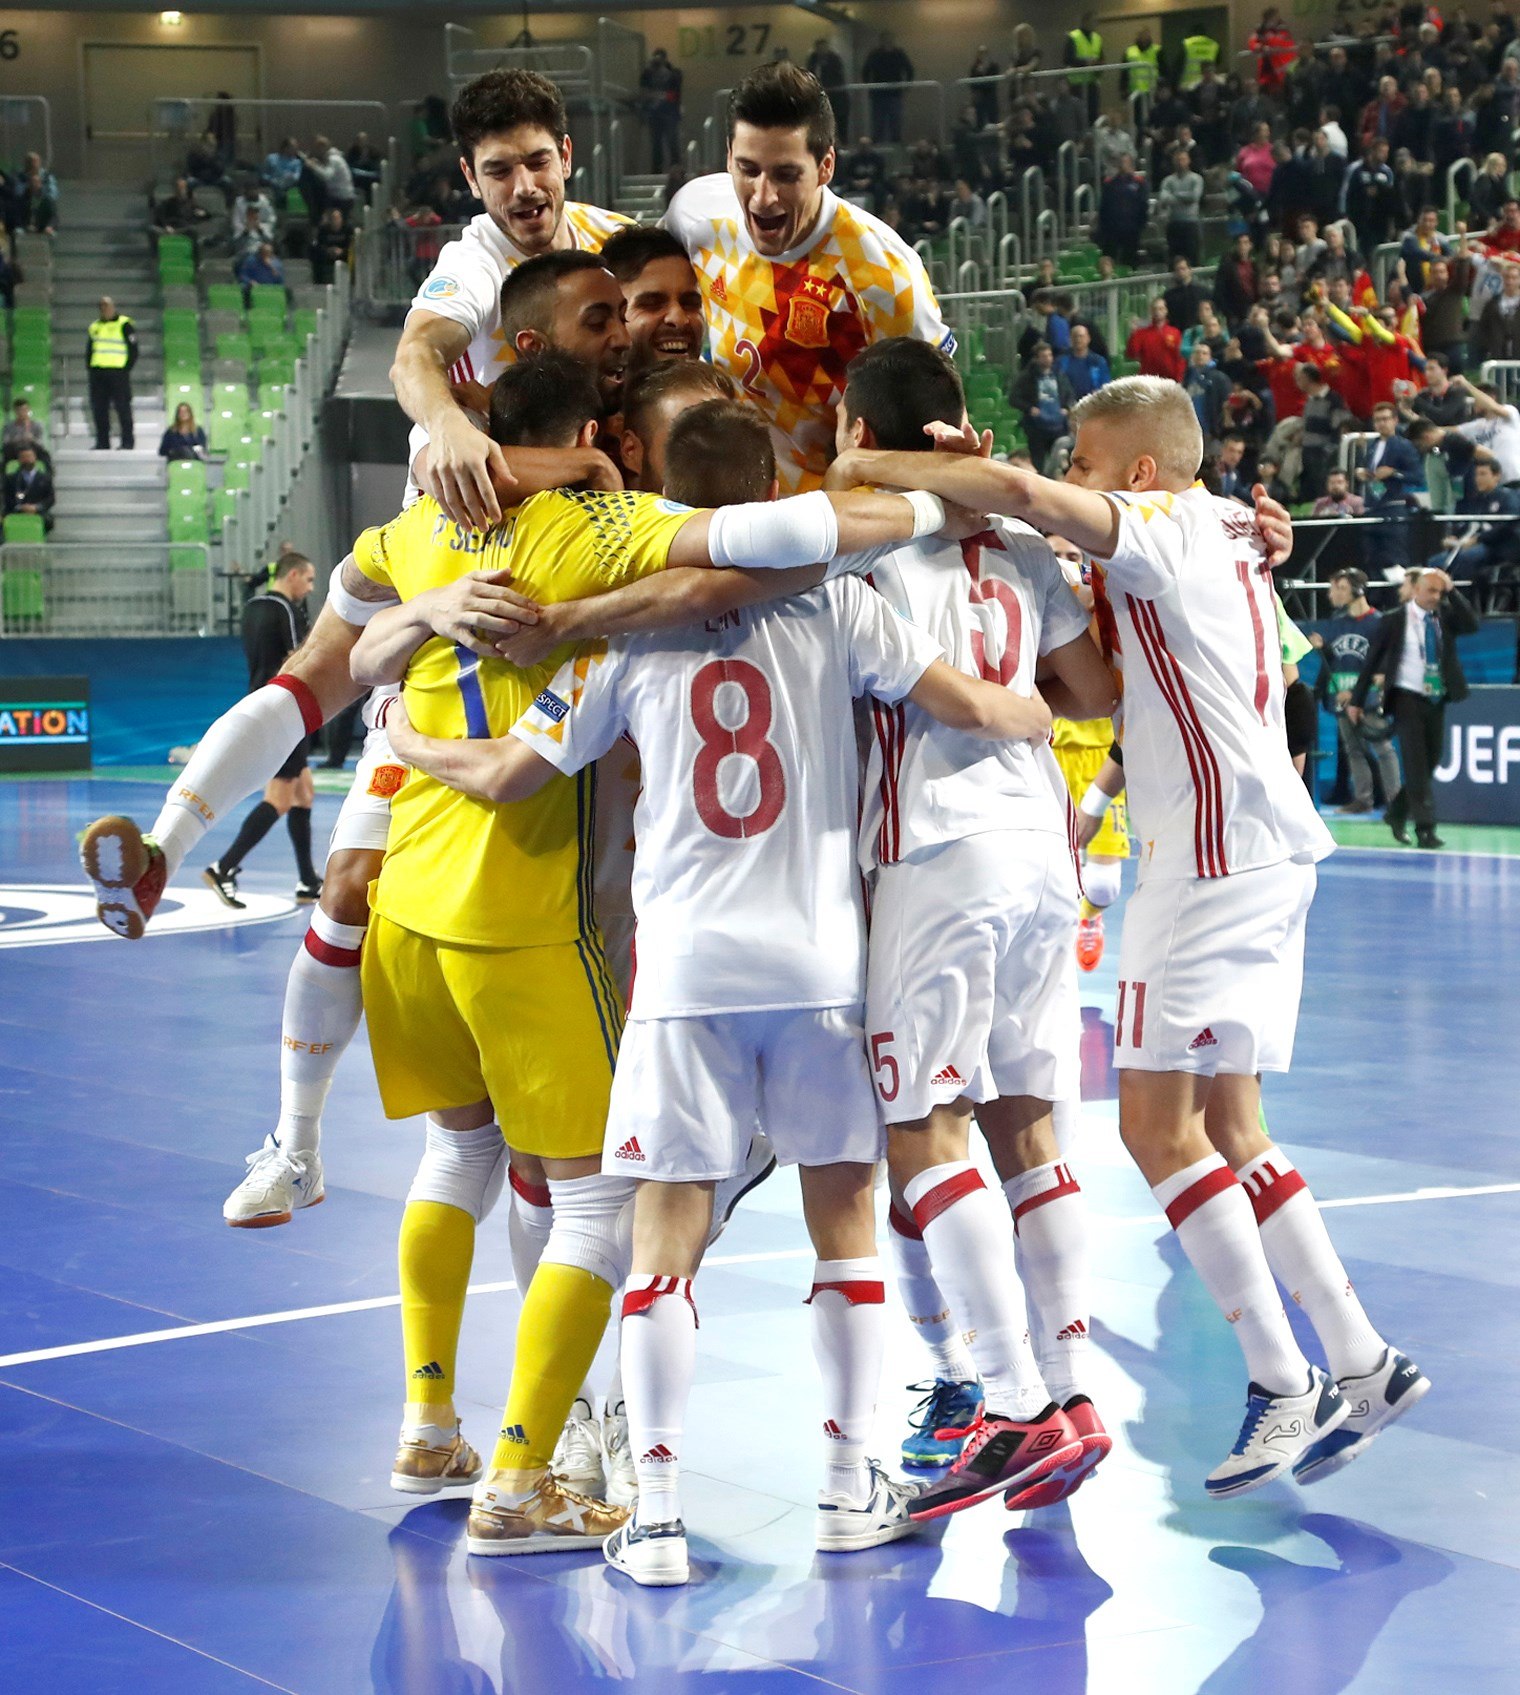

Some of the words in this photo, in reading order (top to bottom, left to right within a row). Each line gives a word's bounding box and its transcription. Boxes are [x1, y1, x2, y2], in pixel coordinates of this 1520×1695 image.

[726, 23, 771, 56] 27
[734, 338, 767, 398] 2
[689, 656, 788, 841] 8
[1115, 980, 1147, 1049] 11
[871, 1031, 900, 1103] 5
[930, 1077, 968, 1087] adidas
[614, 1149, 647, 1162] adidas
[639, 1454, 678, 1464] adidas
